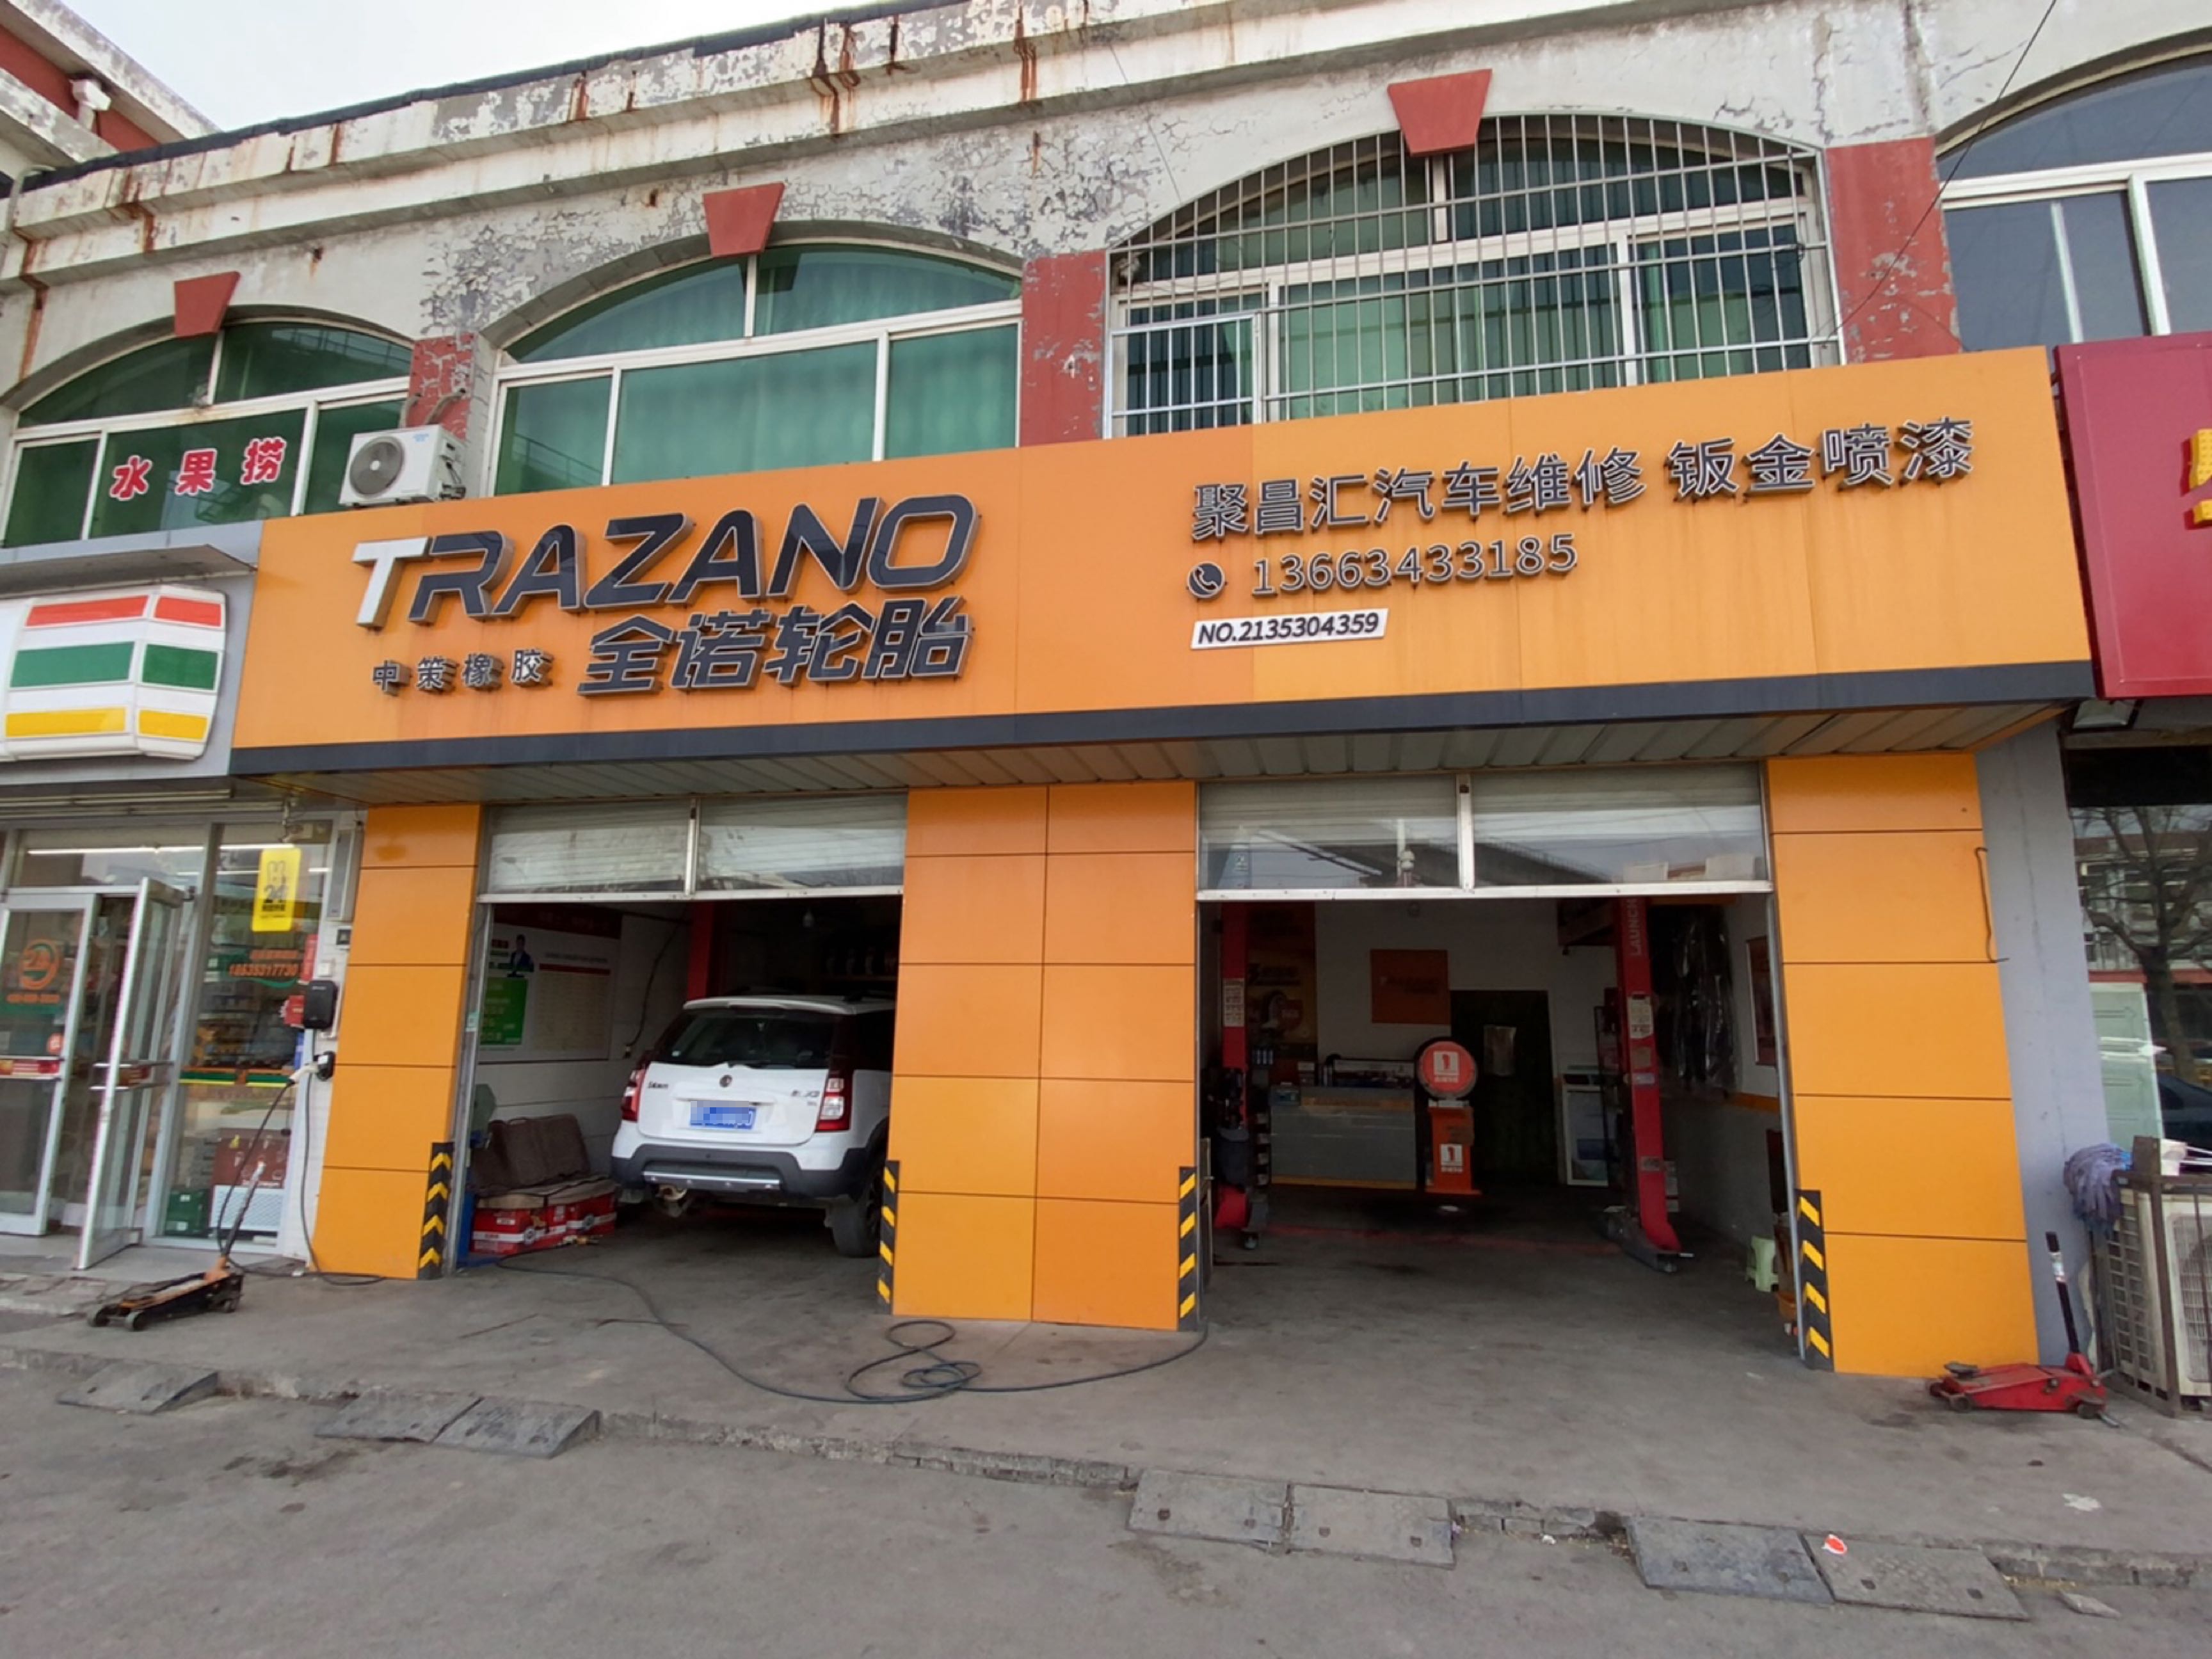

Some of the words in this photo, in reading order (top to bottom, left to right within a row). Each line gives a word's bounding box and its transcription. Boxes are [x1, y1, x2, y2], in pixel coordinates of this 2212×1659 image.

[109, 436, 287, 501] 水果捞
[1191, 446, 1647, 541] 聚昌汇汽车维修
[1667, 416, 1975, 498] 钣金喷漆
[352, 494, 975, 627] TRAZANO
[1253, 533, 1579, 597] 13663433185
[577, 595, 972, 696] 全诺轮胎
[1198, 611, 1380, 644] NO.2135304359
[373, 649, 543, 693] 中策橡胶
